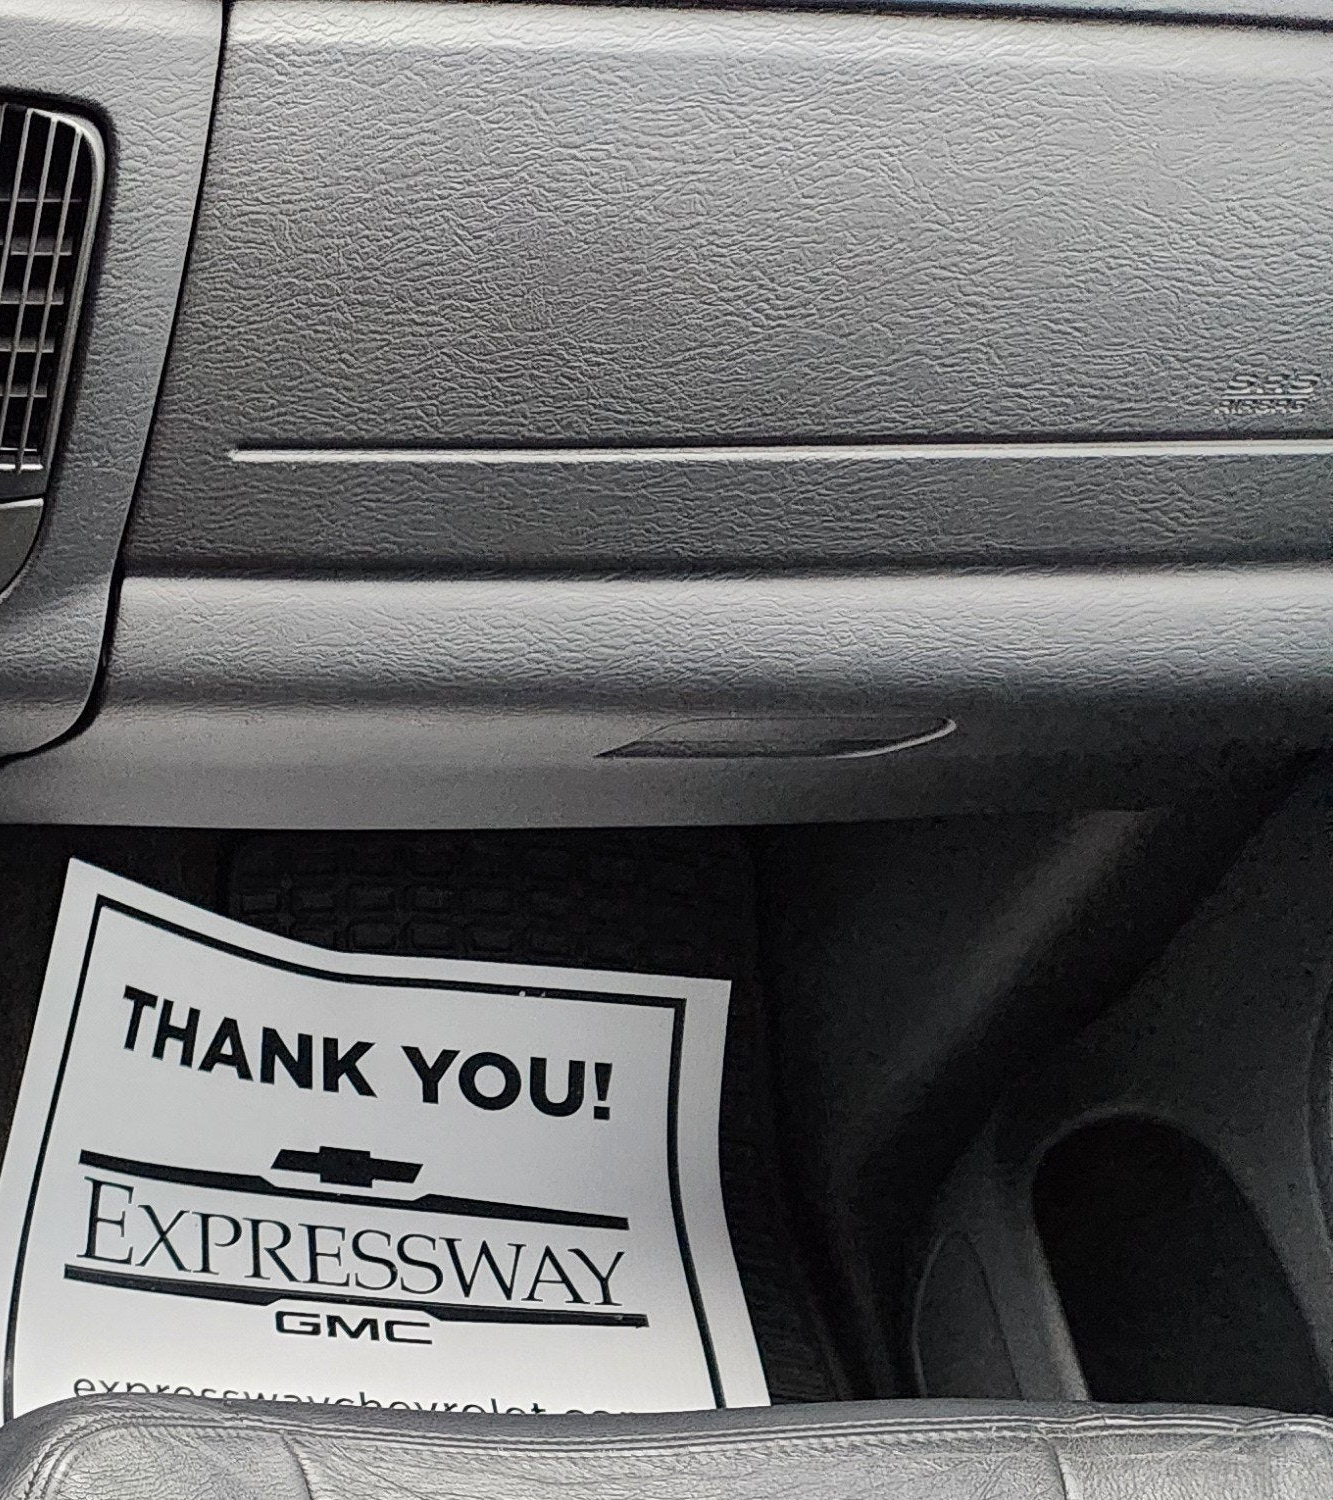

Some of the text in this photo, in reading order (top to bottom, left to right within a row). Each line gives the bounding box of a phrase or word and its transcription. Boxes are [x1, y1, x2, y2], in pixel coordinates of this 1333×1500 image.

[122, 984, 616, 1121] THANK YOU!
[273, 1310, 435, 1346] GMC
